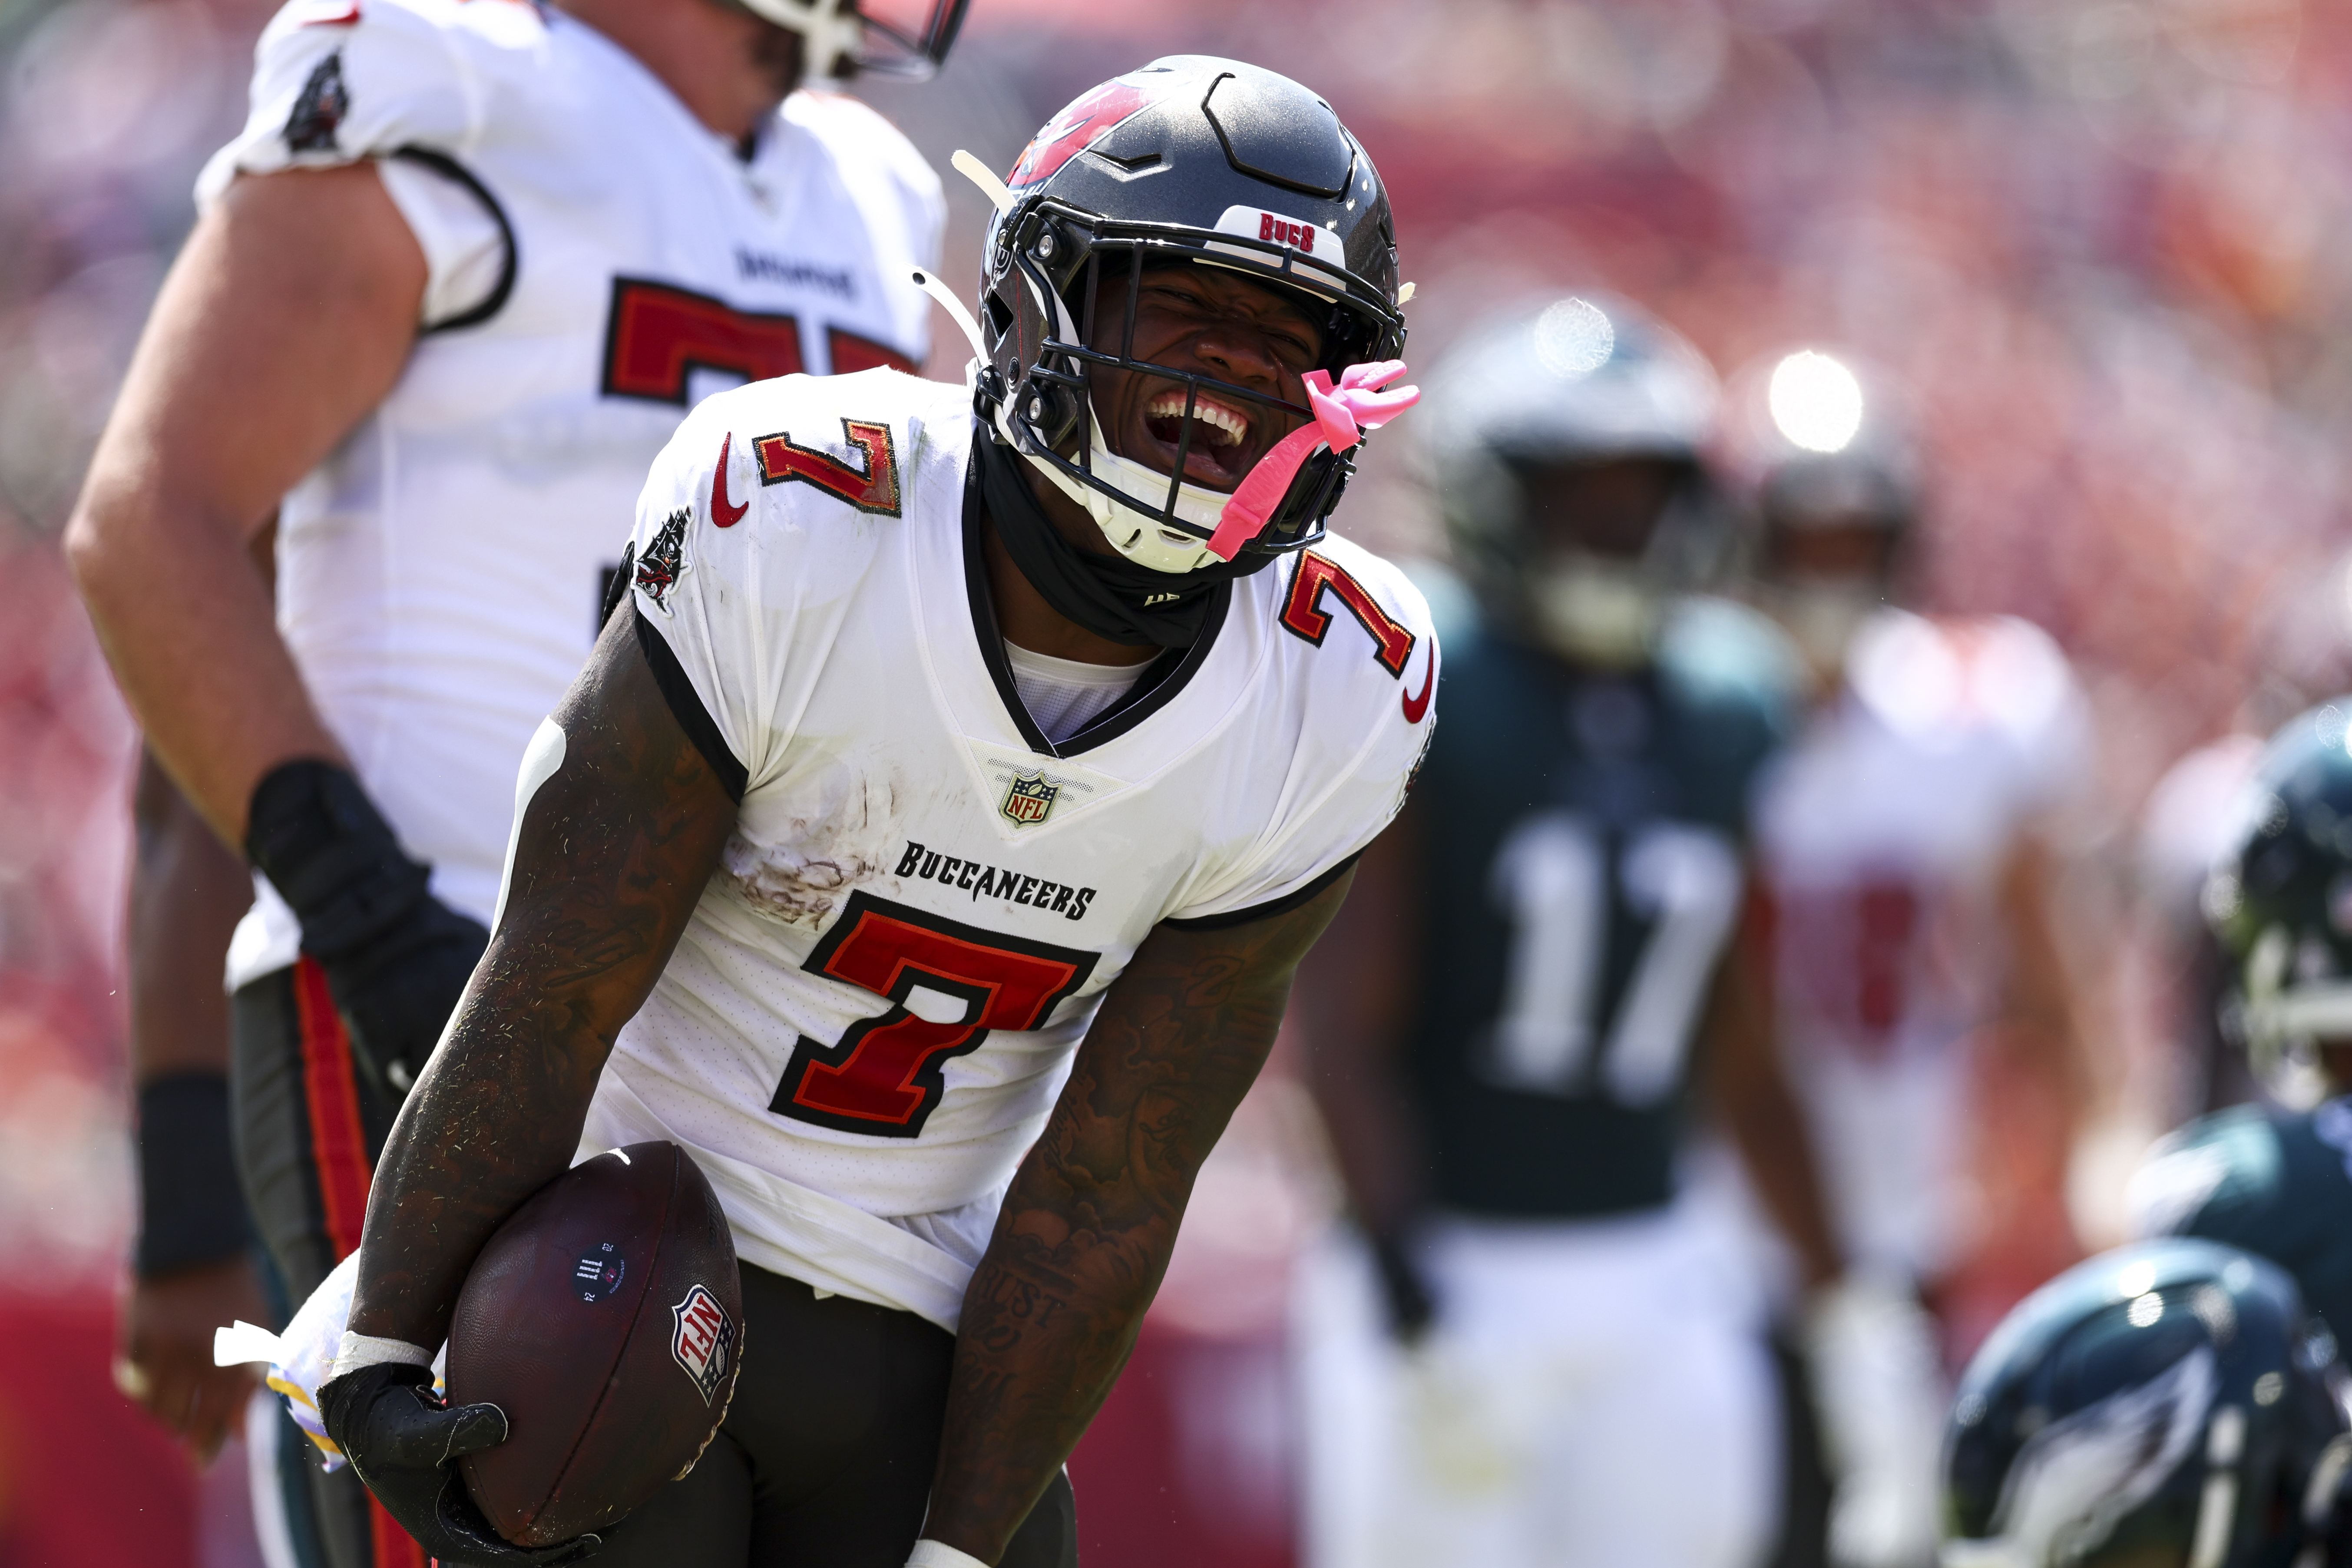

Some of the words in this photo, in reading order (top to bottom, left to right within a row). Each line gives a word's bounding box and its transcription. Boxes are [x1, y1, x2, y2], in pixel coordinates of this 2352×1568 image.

[1259, 213, 1315, 253] BUCS
[752, 417, 901, 519] 7
[1278, 549, 1416, 680] 7
[1008, 795, 1043, 820] NFL
[894, 840, 1097, 920] BUCCANEERS
[1482, 812, 1743, 1108] 17
[768, 889, 1102, 1138] 7
[576, 1259, 603, 1280] 111
[602, 1243, 614, 1252] 20
[584, 1292, 595, 1302] 24
[680, 1295, 721, 1368] NFL
